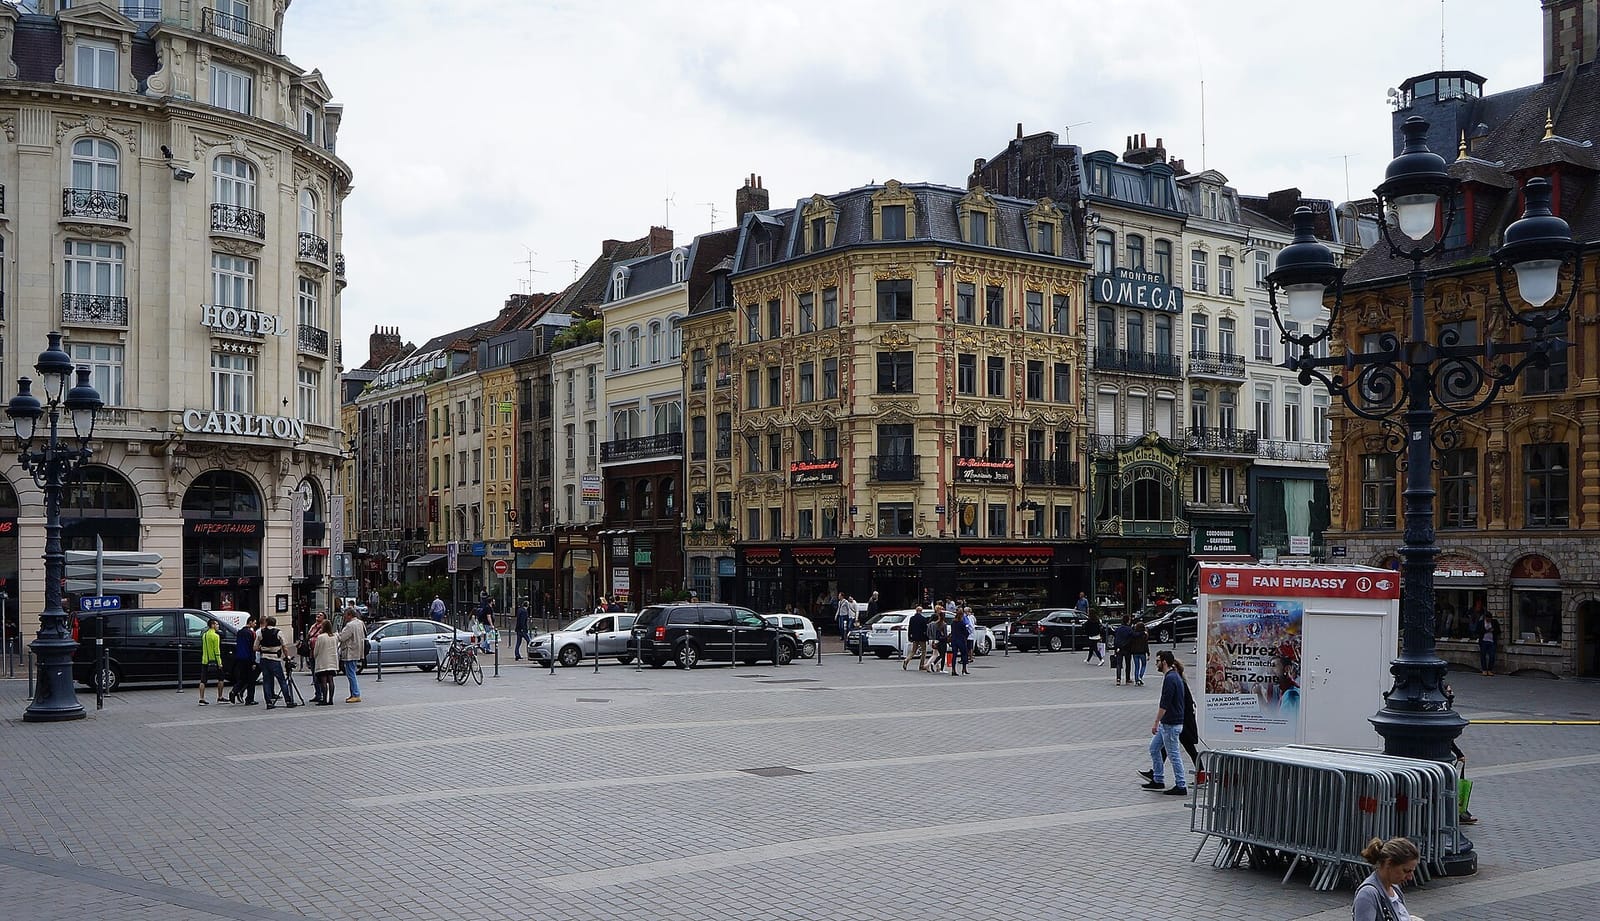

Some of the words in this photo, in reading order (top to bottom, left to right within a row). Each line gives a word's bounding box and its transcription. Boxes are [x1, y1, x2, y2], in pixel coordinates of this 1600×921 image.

[1120, 270, 1160, 283] MONTRE
[1101, 278, 1177, 311] OMEGA
[200, 304, 288, 337] HOTEL
[183, 409, 305, 439] CARLTON
[1136, 447, 1159, 461] Cloche
[993, 471, 1009, 480] Jean
[877, 556, 916, 566] PAUL
[1463, 569, 1485, 577] coffee
[1252, 576, 1279, 587] FAN
[1283, 577, 1347, 589] EMBASSY
[1227, 643, 1276, 656] Vibrez
